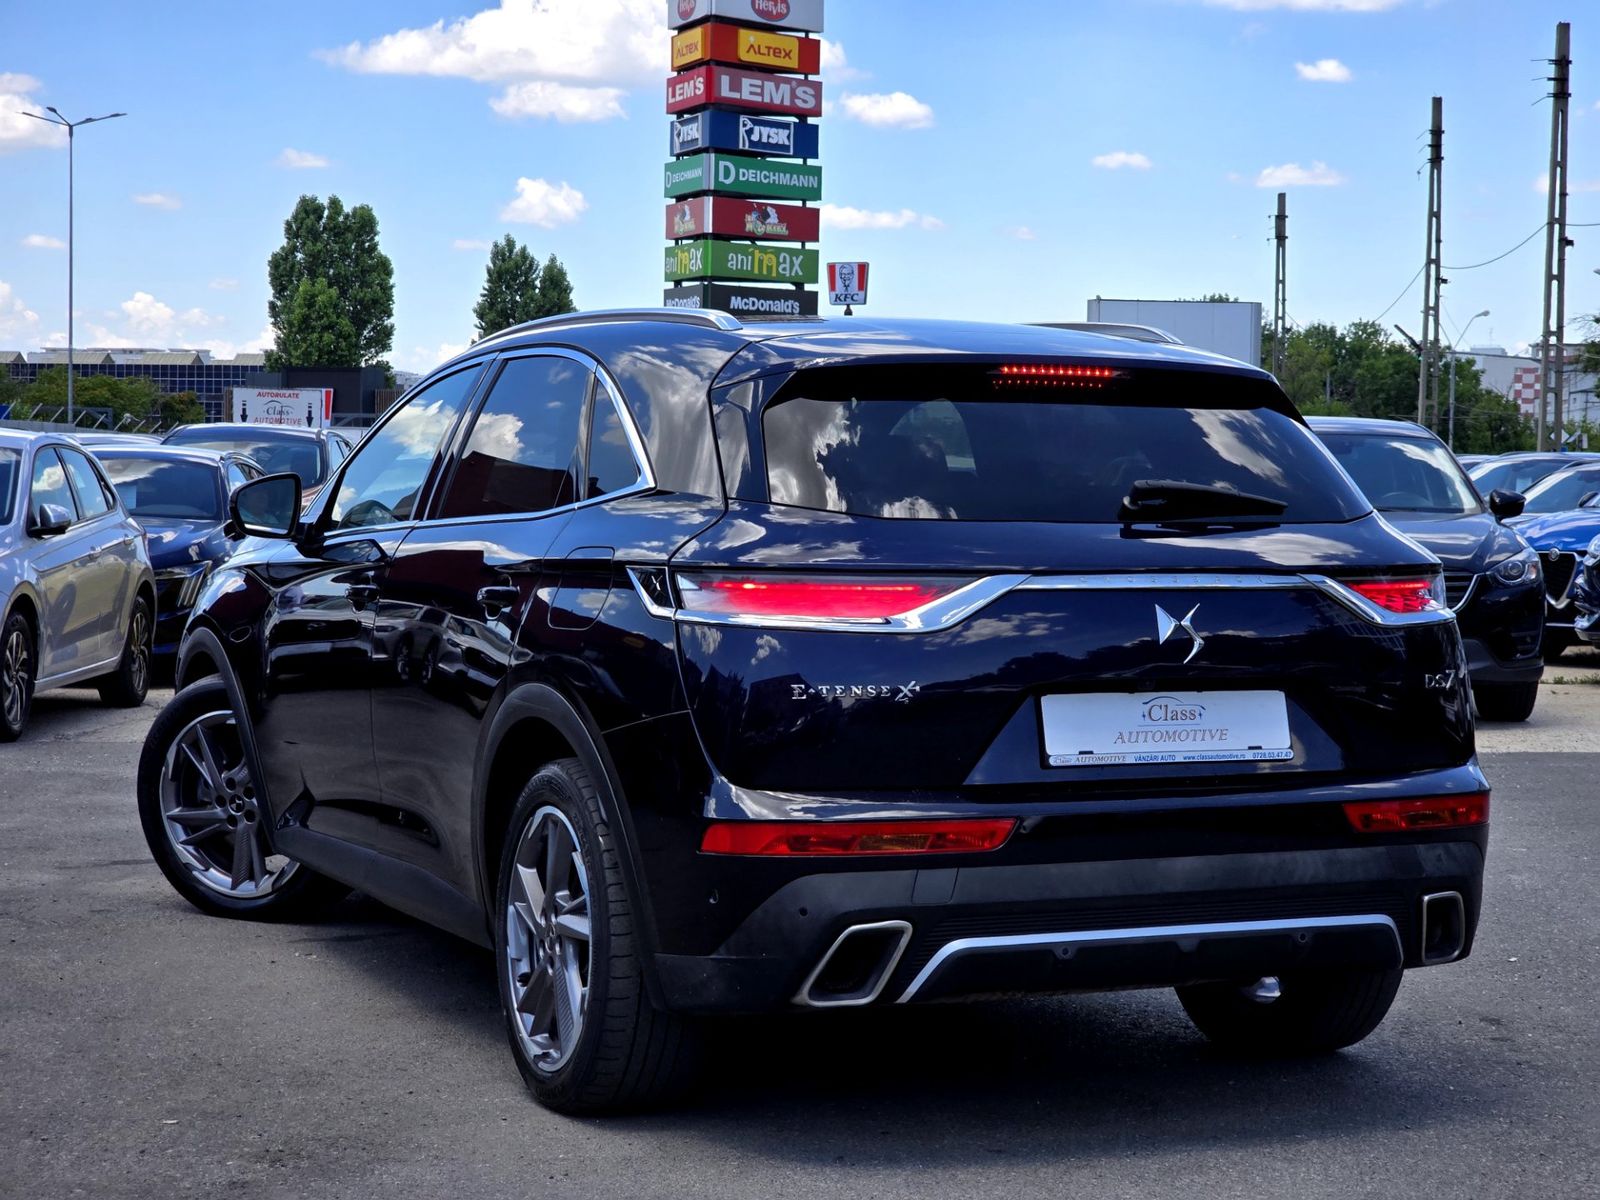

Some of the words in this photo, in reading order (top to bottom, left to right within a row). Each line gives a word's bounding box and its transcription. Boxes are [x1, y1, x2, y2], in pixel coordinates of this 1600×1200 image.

[668, 76, 704, 104] LEM'S
[720, 74, 816, 109] LEM'S
[679, 122, 700, 144] JYSK
[750, 126, 791, 145] JYSK
[673, 167, 703, 183] DEICHMANN
[739, 168, 818, 189] DEICHMANN
[665, 247, 702, 274] animax
[728, 247, 804, 277] animax
[730, 295, 800, 314] McDonald's
[834, 292, 859, 302] KFC
[256, 391, 300, 399] AUTORULATE
[254, 416, 302, 425] AUTOMOTIVE
[1147, 704, 1197, 722] Class
[1113, 728, 1229, 745] AUTOMOTIVE
[1075, 755, 1127, 763] AUTOMOTIVE
